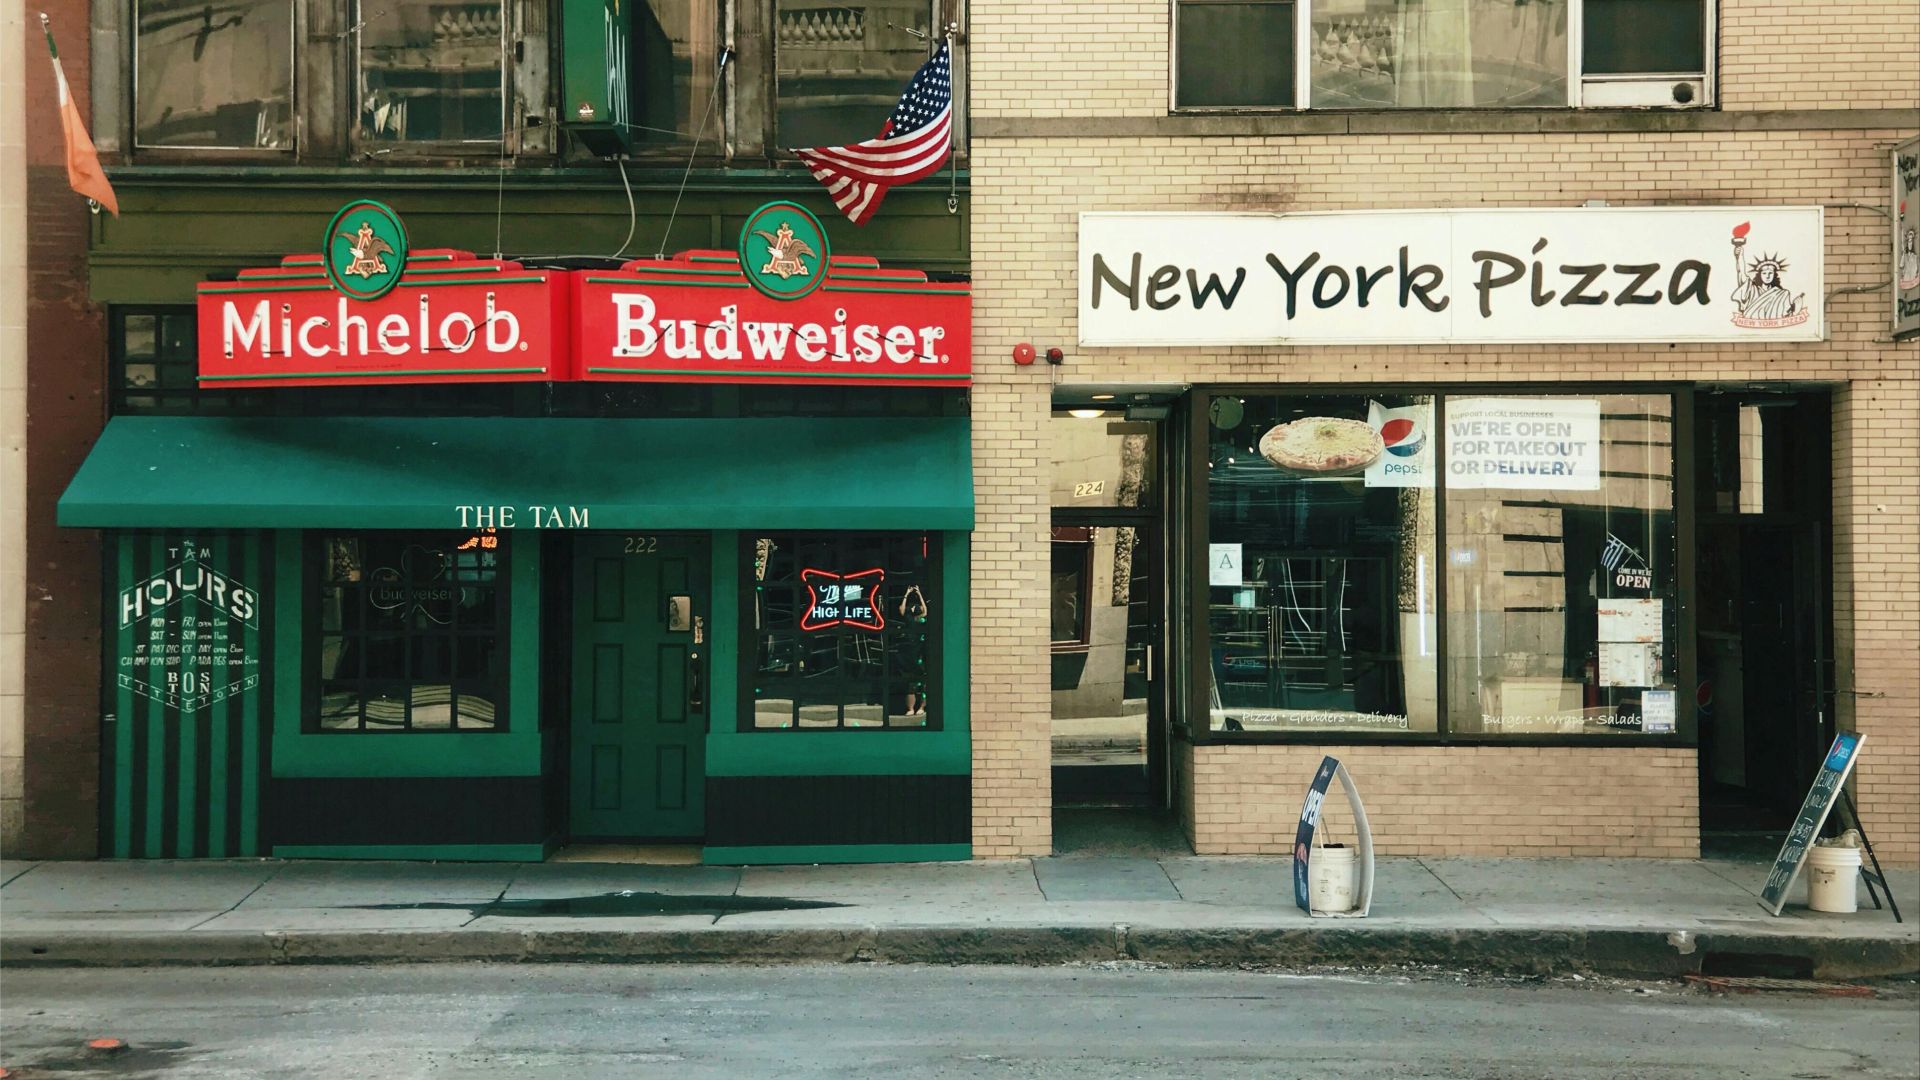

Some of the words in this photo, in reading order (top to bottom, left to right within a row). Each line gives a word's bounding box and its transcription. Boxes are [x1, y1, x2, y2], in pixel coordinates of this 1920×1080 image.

[1091, 252, 1246, 311] New
[1265, 246, 1450, 320] York
[1472, 237, 1711, 318] Pizza
[1781, 315, 1805, 326] PIZZA
[1450, 411, 1483, 420] SUPPORT
[1451, 421, 1512, 437] WE'RE
[1516, 422, 1572, 437] OPEN
[1451, 440, 1490, 456] FOR
[1494, 441, 1587, 457] TAKEOUT
[1384, 463, 1422, 476] pepsi
[1450, 460, 1480, 475] OR
[1484, 460, 1577, 476] DELIVERY
[1076, 482, 1104, 497] 224
[455, 505, 516, 528] THE
[528, 505, 590, 528] TAM
[624, 537, 657, 553] 222
[168, 548, 211, 559] TAM
[1219, 553, 1234, 569] A
[1616, 574, 1652, 589] OPEN
[122, 567, 254, 624] HOURS
[844, 606, 872, 618] LIFE
[150, 617, 165, 628] MON
[182, 616, 196, 628] FRI
[149, 630, 165, 641] SAT
[182, 630, 197, 640] SUN
[135, 644, 147, 654] ST
[122, 677, 255, 711] TITLETOWN
[1242, 711, 1278, 723] Pizza
[1289, 710, 1346, 724] Grinders
[1357, 711, 1408, 728] Delivery
[1482, 714, 1533, 727] Burgers
[1544, 714, 1586, 728] Wraps
[1596, 713, 1642, 725] Salads
